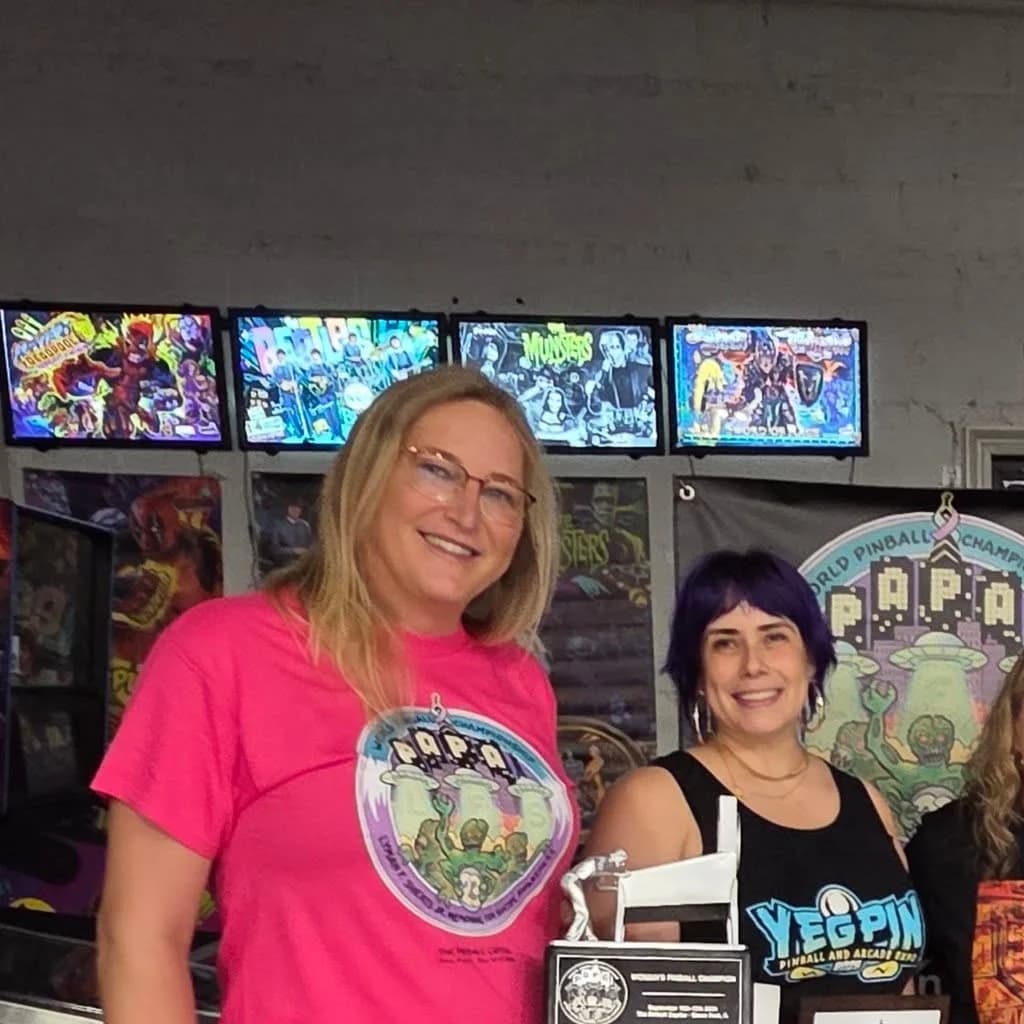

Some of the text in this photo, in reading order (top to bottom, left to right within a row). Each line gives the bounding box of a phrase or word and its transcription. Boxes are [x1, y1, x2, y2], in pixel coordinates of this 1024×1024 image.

[853, 528, 931, 562] PINBALL
[831, 567, 1015, 637] PAPA
[392, 730, 507, 769] PAPA
[755, 893, 923, 958] YEGPIN
[779, 951, 825, 971] PINBALL
[829, 949, 851, 961] AND
[852, 948, 892, 960] ARCADE
